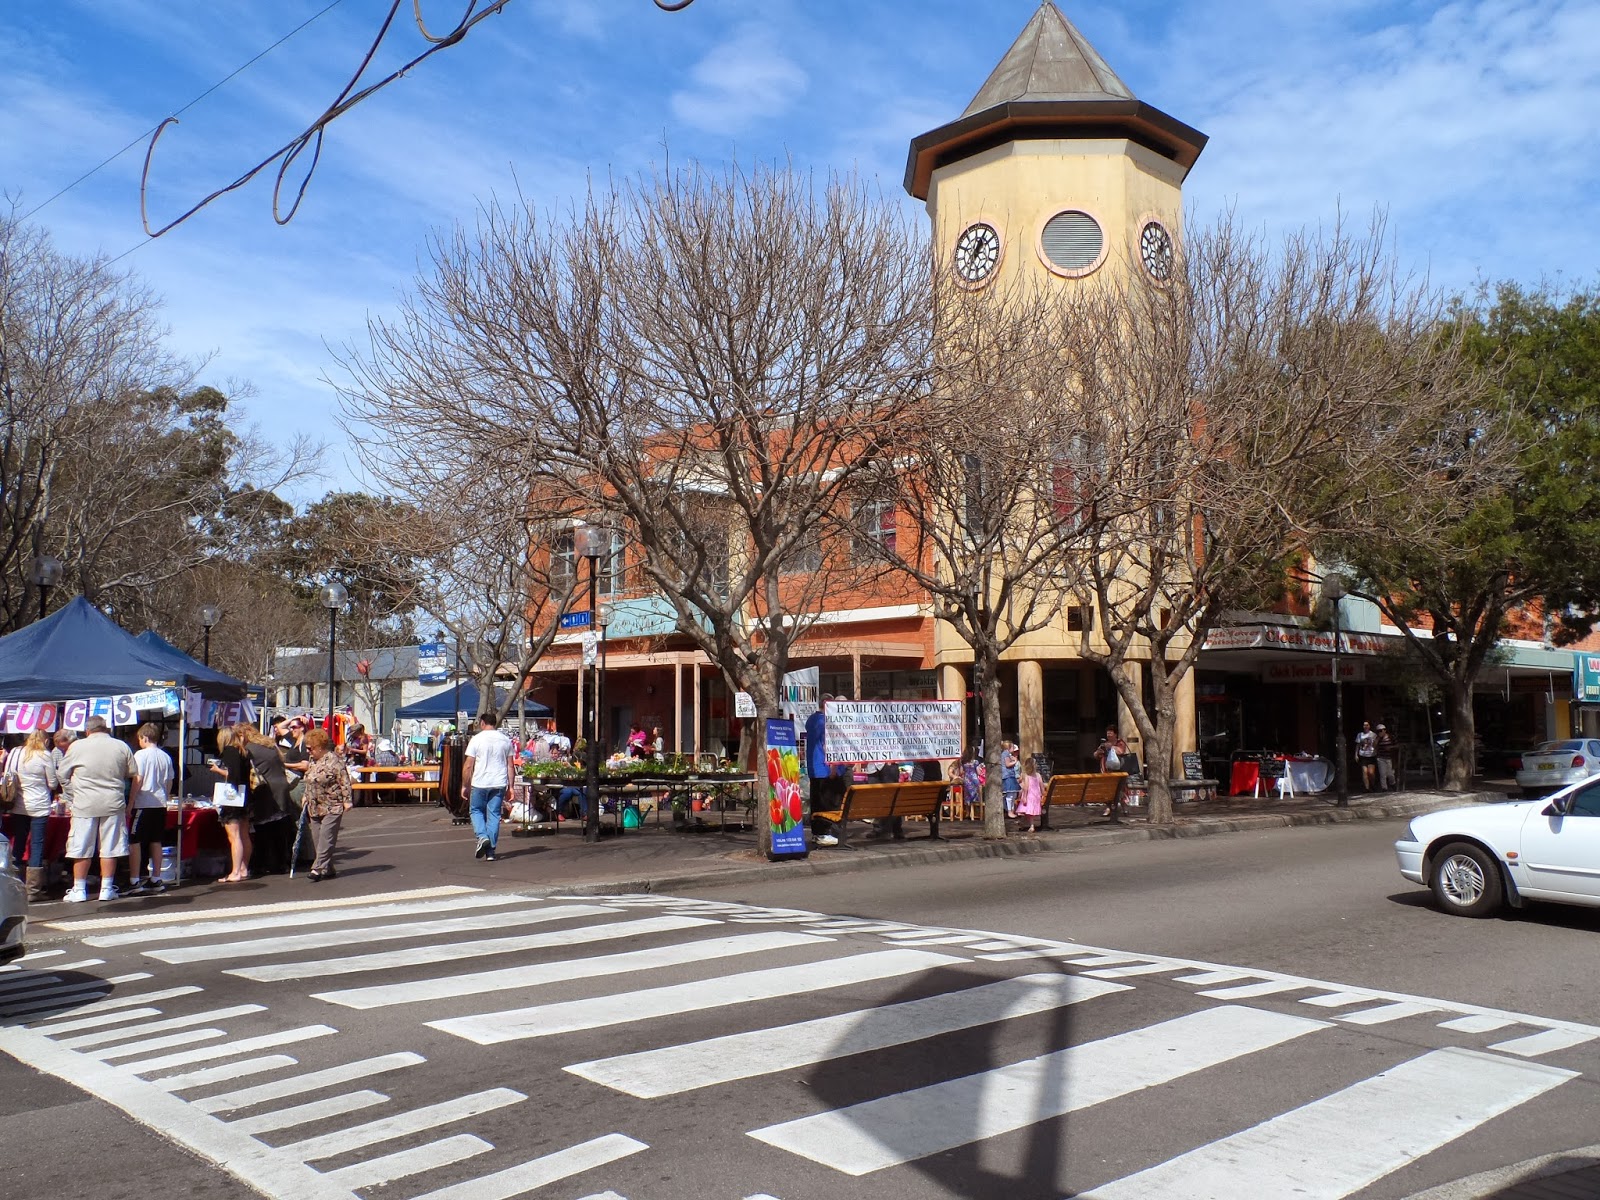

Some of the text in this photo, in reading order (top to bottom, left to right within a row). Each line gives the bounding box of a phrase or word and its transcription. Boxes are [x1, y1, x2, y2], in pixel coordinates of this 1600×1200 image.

[1266, 627, 1303, 645] Clock
[837, 703, 953, 714] HAMILTON CLOCKTOWER
[825, 714, 918, 724] PLANTS HATS MARKETS
[903, 723, 926, 731] EVERY
[926, 723, 961, 731] SATURDAY
[860, 738, 878, 746] LIVE
[878, 737, 938, 746] ENTERTAINMENT
[938, 738, 960, 746] HERBS
[826, 752, 881, 762] BEAUMONT
[881, 751, 893, 760] ST
[935, 748, 941, 757] 9
[942, 746, 954, 756] till
